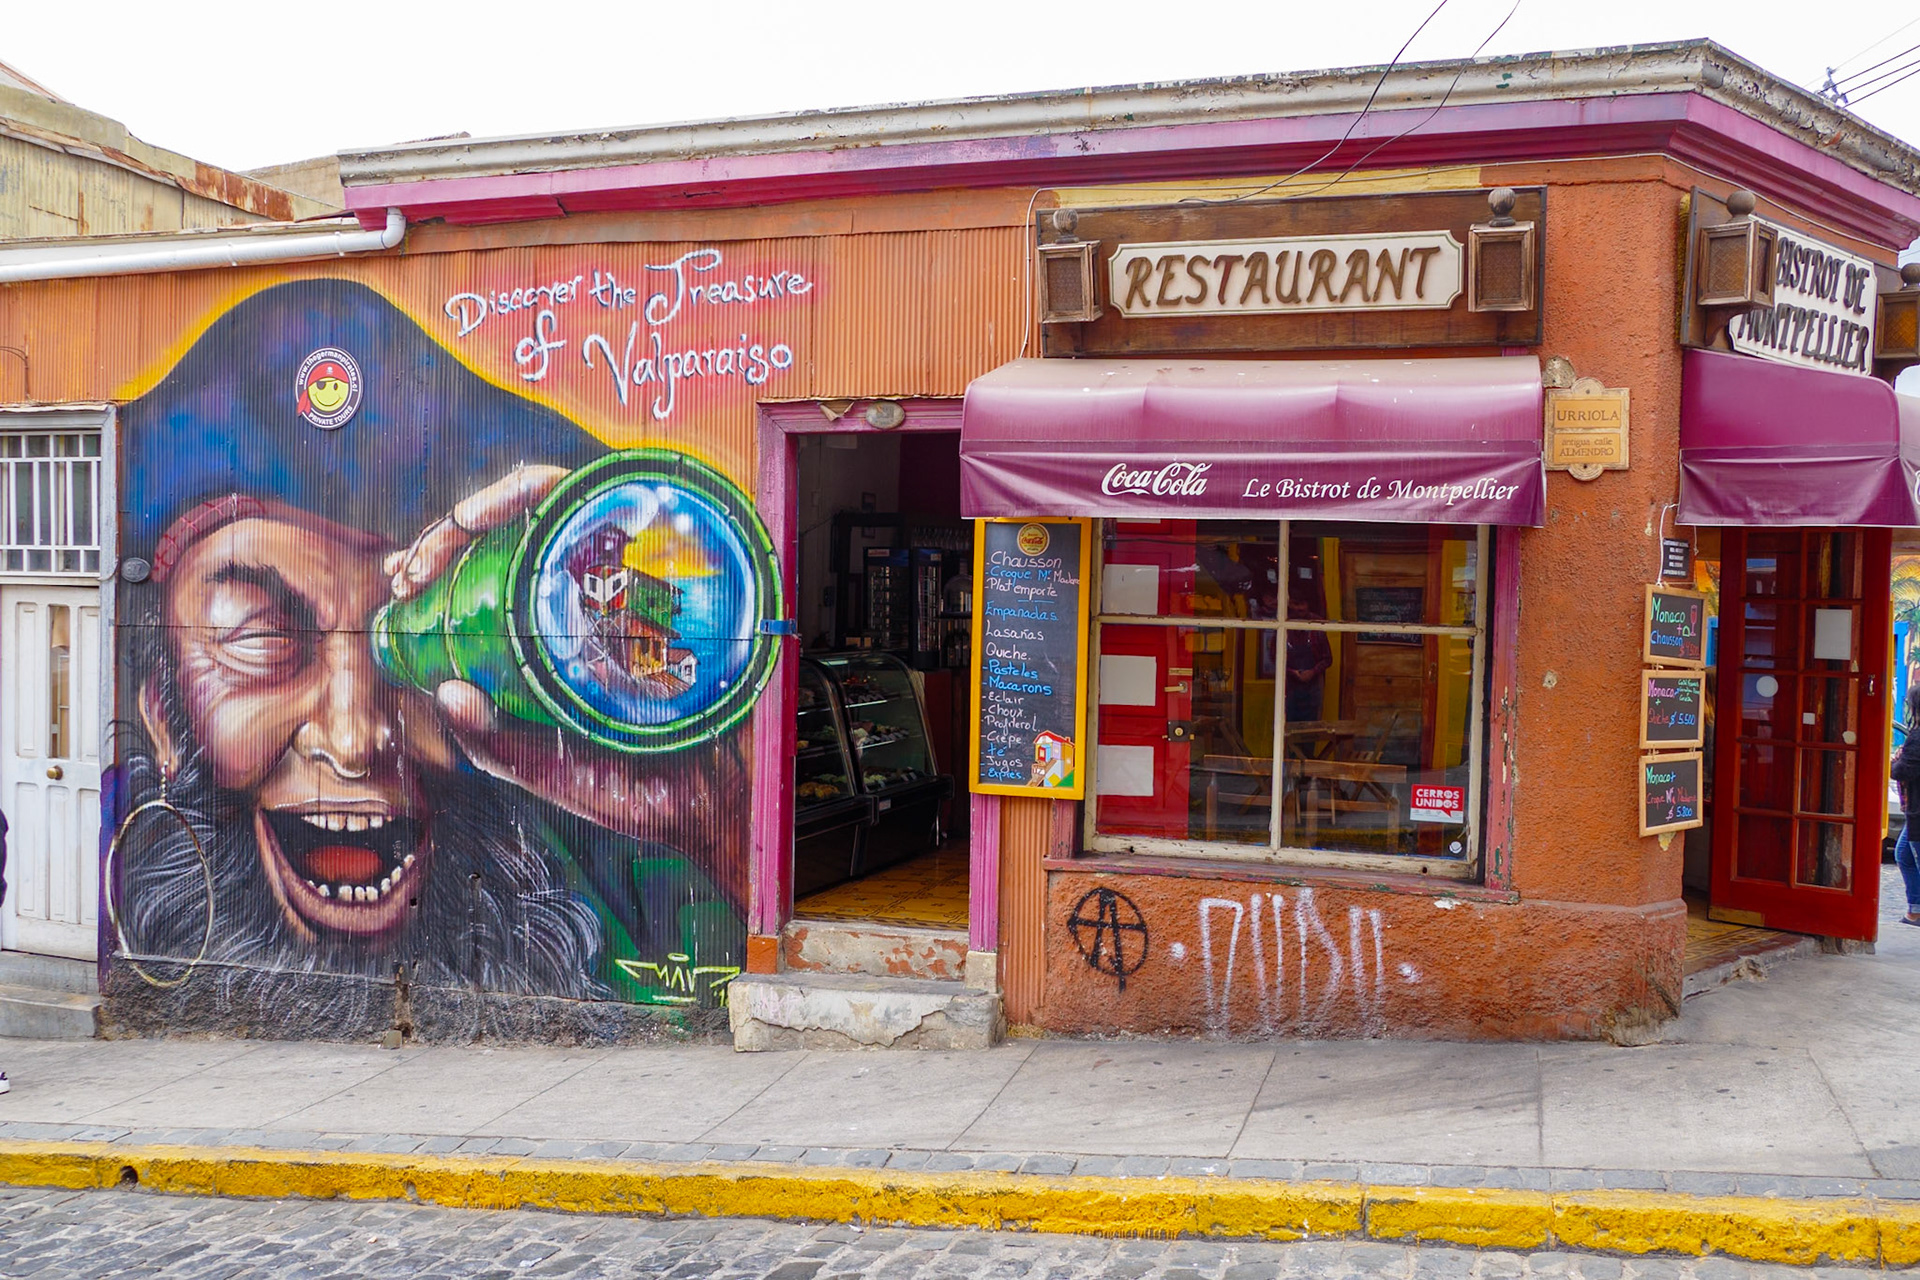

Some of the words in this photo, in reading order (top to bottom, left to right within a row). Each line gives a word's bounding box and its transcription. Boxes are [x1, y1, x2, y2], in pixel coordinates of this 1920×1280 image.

[1125, 246, 1441, 309] RESTAURANT
[1776, 237, 1846, 302] BISTROT
[1843, 263, 1870, 314] DE
[443, 275, 583, 337] Discover
[589, 269, 636, 309] the
[645, 248, 813, 326] Treasure
[514, 310, 566, 382] of
[583, 321, 793, 421] Valparaiso
[308, 412, 333, 425] PRIVATE
[335, 405, 353, 422] TOURS
[1557, 410, 1620, 421] URRIOLA
[1559, 448, 1614, 457] ALMENDRO
[1101, 463, 1213, 496] Coca-Cola
[1242, 478, 1270, 498] Le
[1275, 478, 1351, 499] Bistrot
[1356, 477, 1381, 499] de
[1387, 478, 1518, 505] Montpellier
[990, 551, 1062, 568] Chausson
[987, 577, 1013, 591] Plat
[985, 601, 1059, 621] Empanadas
[1650, 597, 1686, 623] Monaco
[986, 620, 1044, 640] Lasañas
[988, 675, 1052, 696] Macarons
[986, 756, 1023, 773] Jugos
[1415, 798, 1459, 809] UNIDOS
[1416, 789, 1459, 799] CERROS
